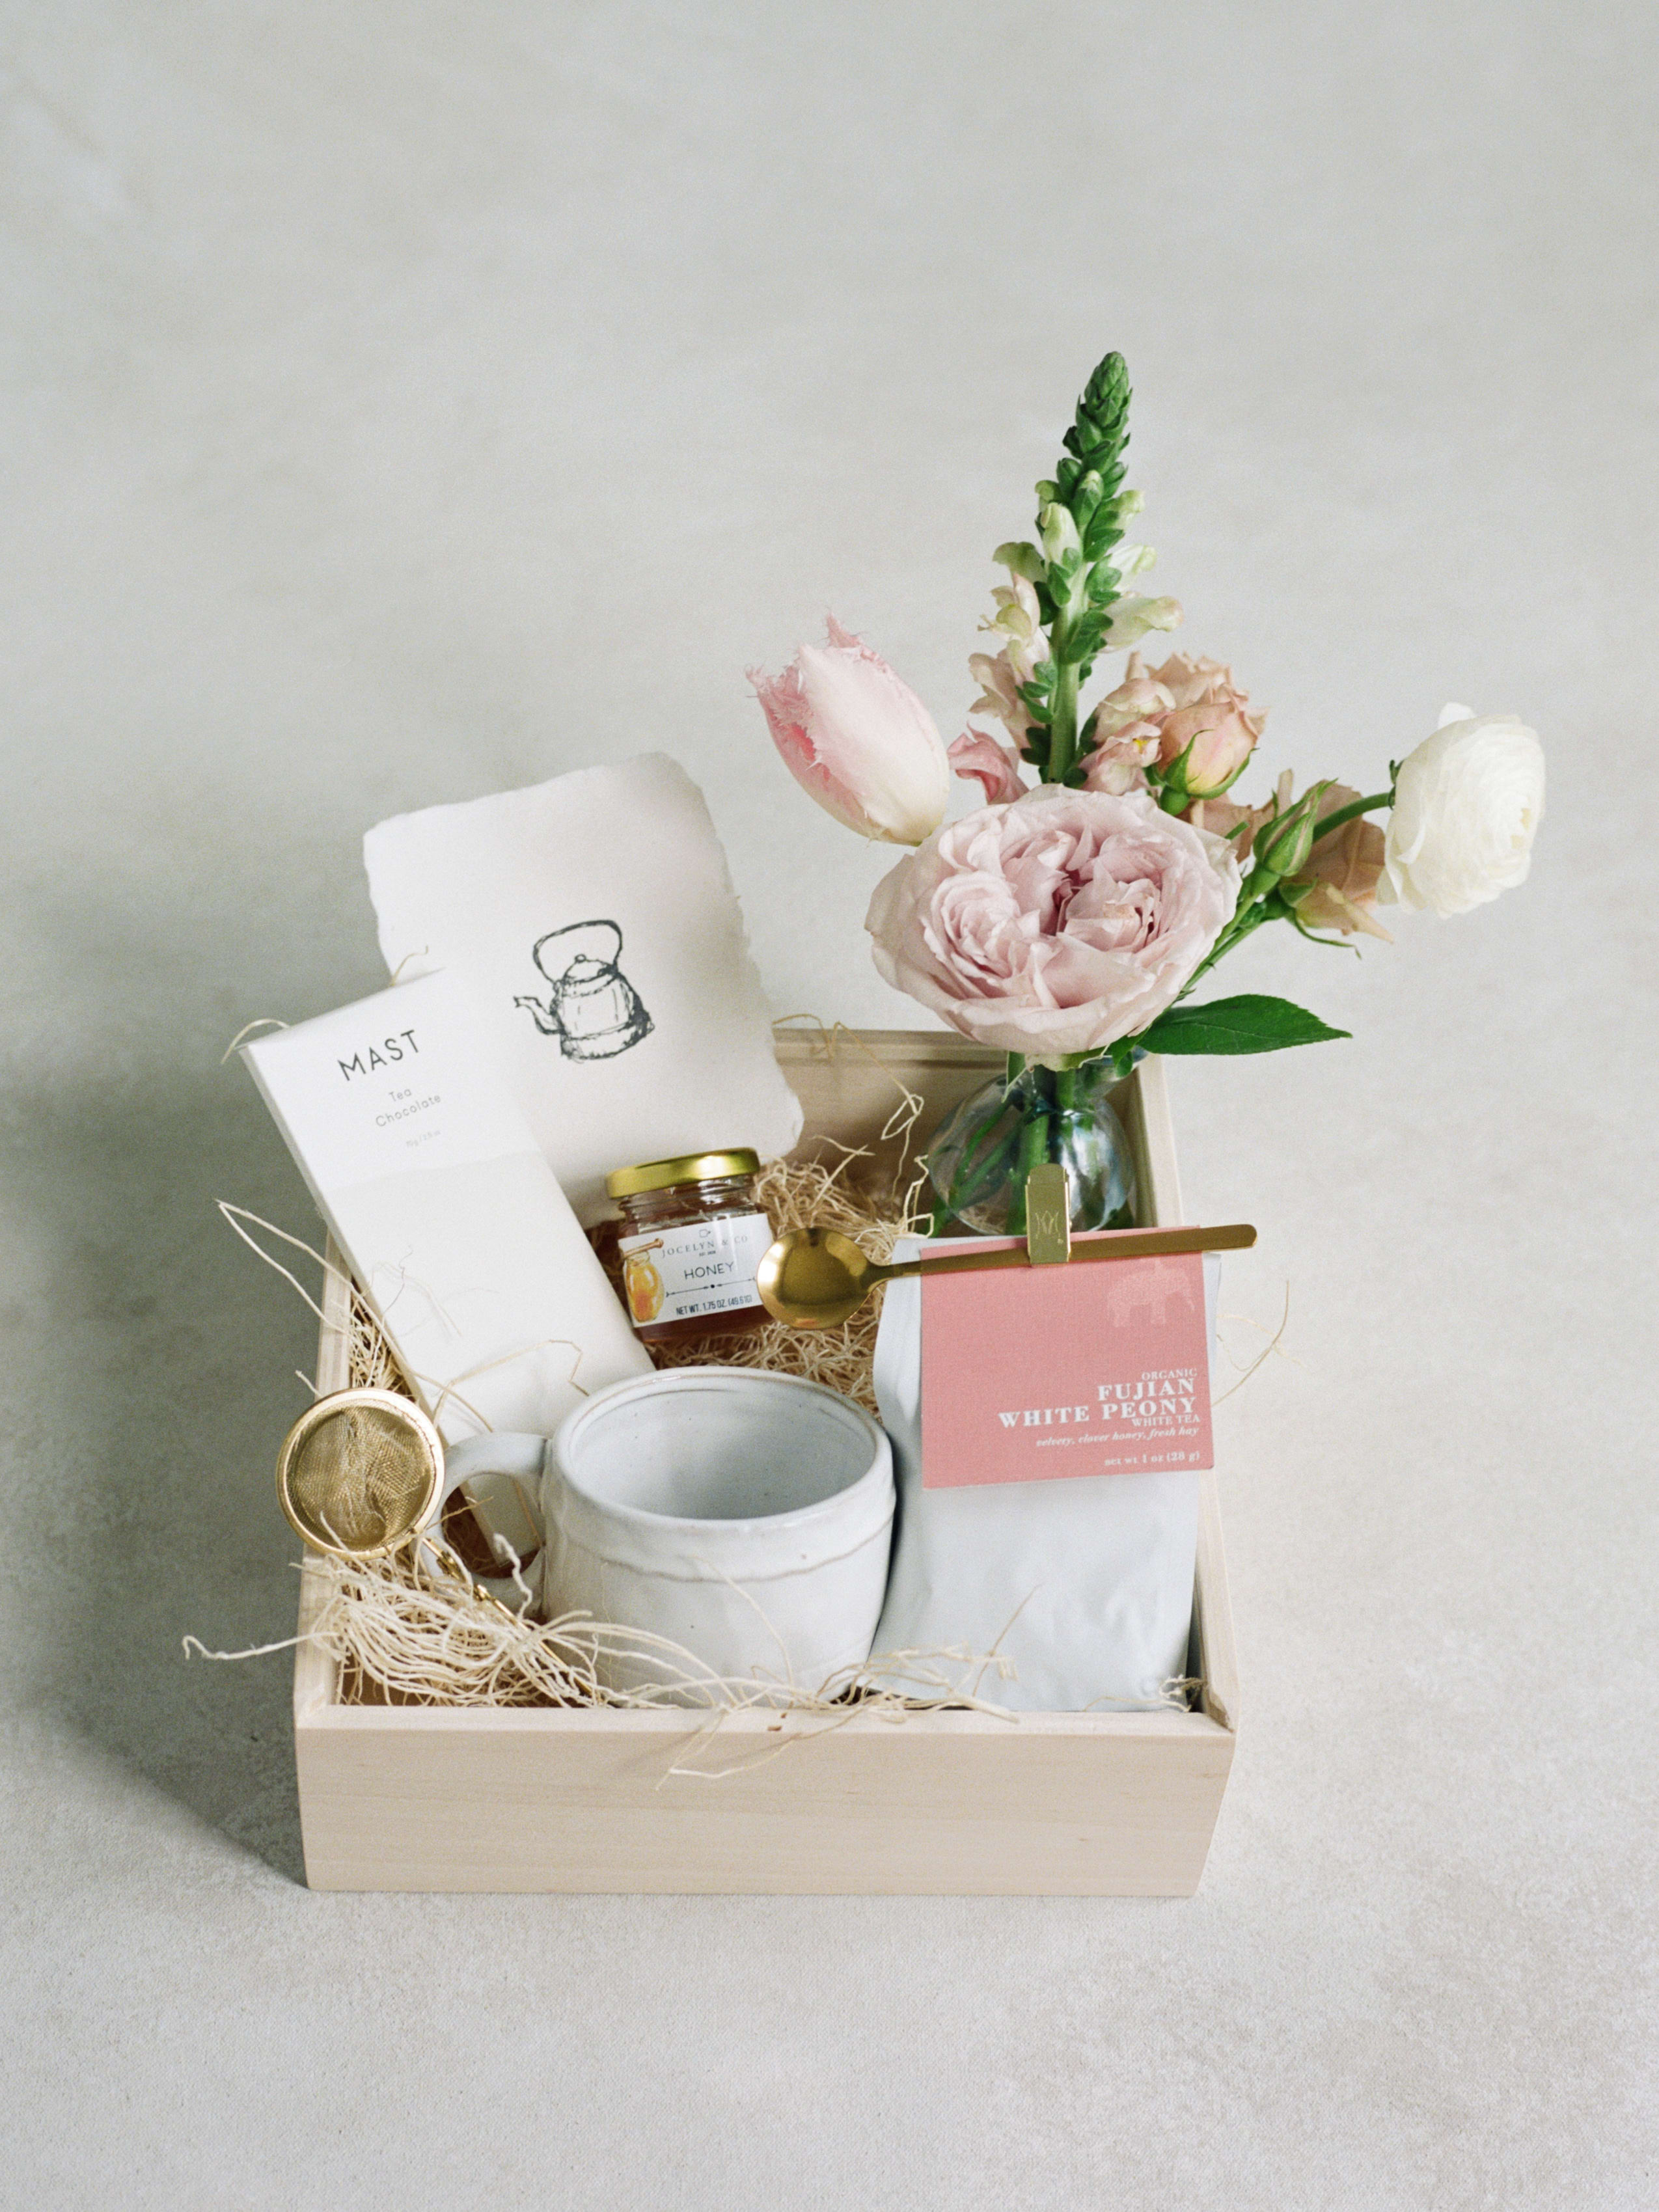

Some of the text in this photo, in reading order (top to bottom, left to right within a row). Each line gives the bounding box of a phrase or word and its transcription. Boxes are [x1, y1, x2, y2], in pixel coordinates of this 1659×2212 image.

[337, 1030, 419, 1081] MAST
[389, 1088, 412, 1102] Tea
[375, 1093, 441, 1127] Chocolate
[662, 1240, 715, 1258] JOCELYN
[684, 1261, 735, 1280] HONEY
[676, 1305, 688, 1316] NET
[703, 1300, 715, 1310] 1.75
[1142, 1367, 1198, 1381] ORGANIC
[1097, 1378, 1196, 1402] FUJIAN
[998, 1397, 1197, 1428] WHITE PEONY
[1131, 1413, 1201, 1428] WHITE TEA
[1078, 1432, 1110, 1443] clover
[1112, 1430, 1146, 1442] honey,
[1147, 1427, 1176, 1442] fresh
[1179, 1426, 1199, 1438] hay
[1104, 1457, 1121, 1466] net
[1125, 1456, 1138, 1465] wt
[1142, 1454, 1147, 1463] 1
[1166, 1451, 1185, 1463] (28
